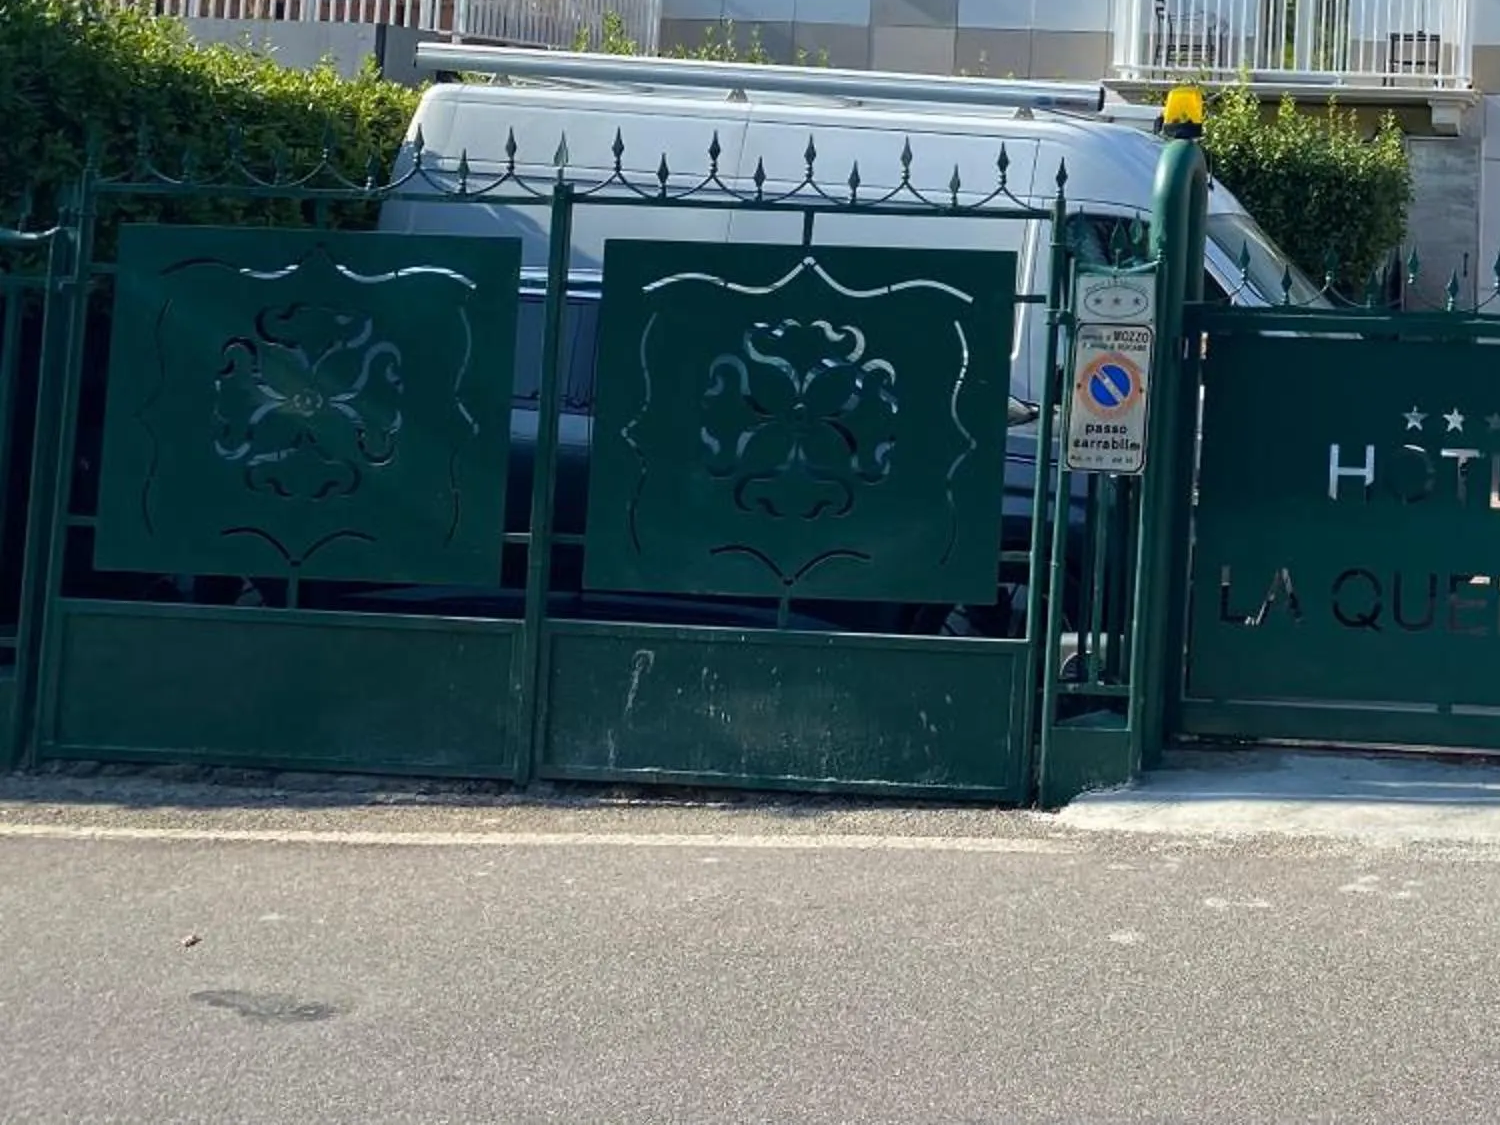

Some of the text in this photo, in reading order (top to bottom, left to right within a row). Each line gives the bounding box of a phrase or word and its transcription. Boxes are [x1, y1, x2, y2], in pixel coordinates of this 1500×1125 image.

[1114, 330, 1149, 343] MOZZO
[1085, 424, 1129, 435] passo
[1218, 565, 1304, 626] LA
